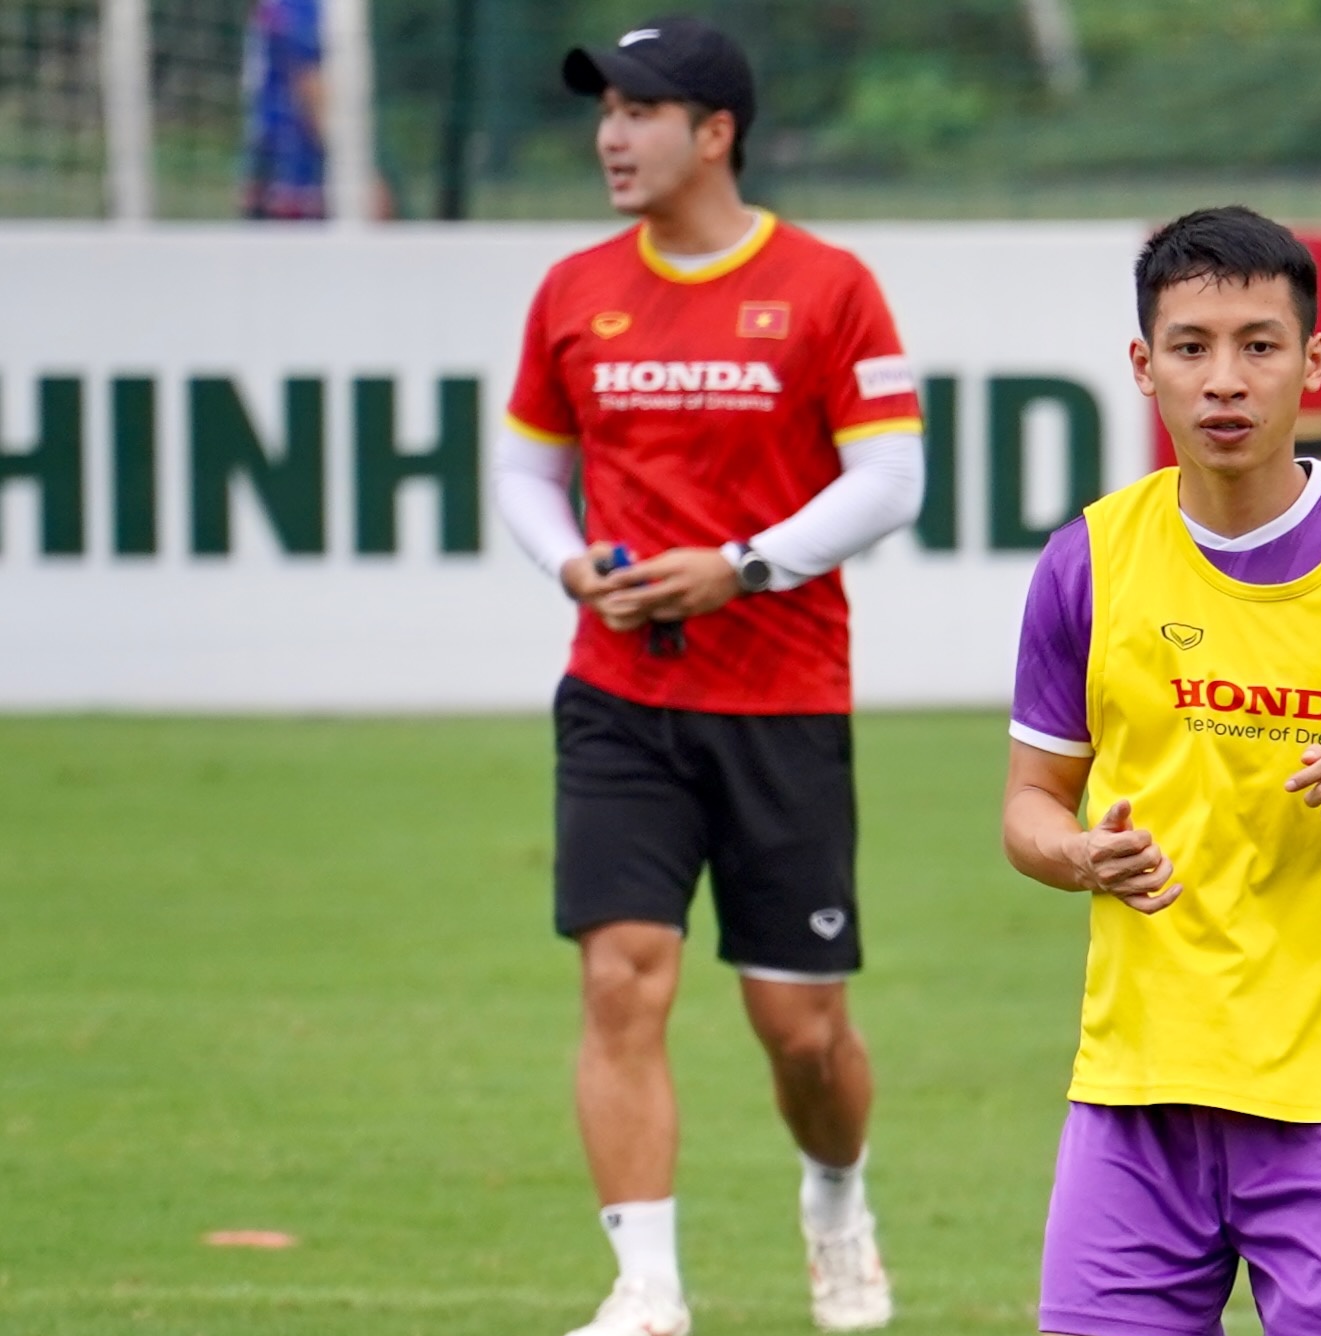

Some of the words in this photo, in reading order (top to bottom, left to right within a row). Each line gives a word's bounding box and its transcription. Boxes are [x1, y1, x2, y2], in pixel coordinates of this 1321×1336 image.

[593, 361, 782, 393] HONDA
[1207, 718, 1265, 740] Power
[1269, 727, 1290, 742] of
